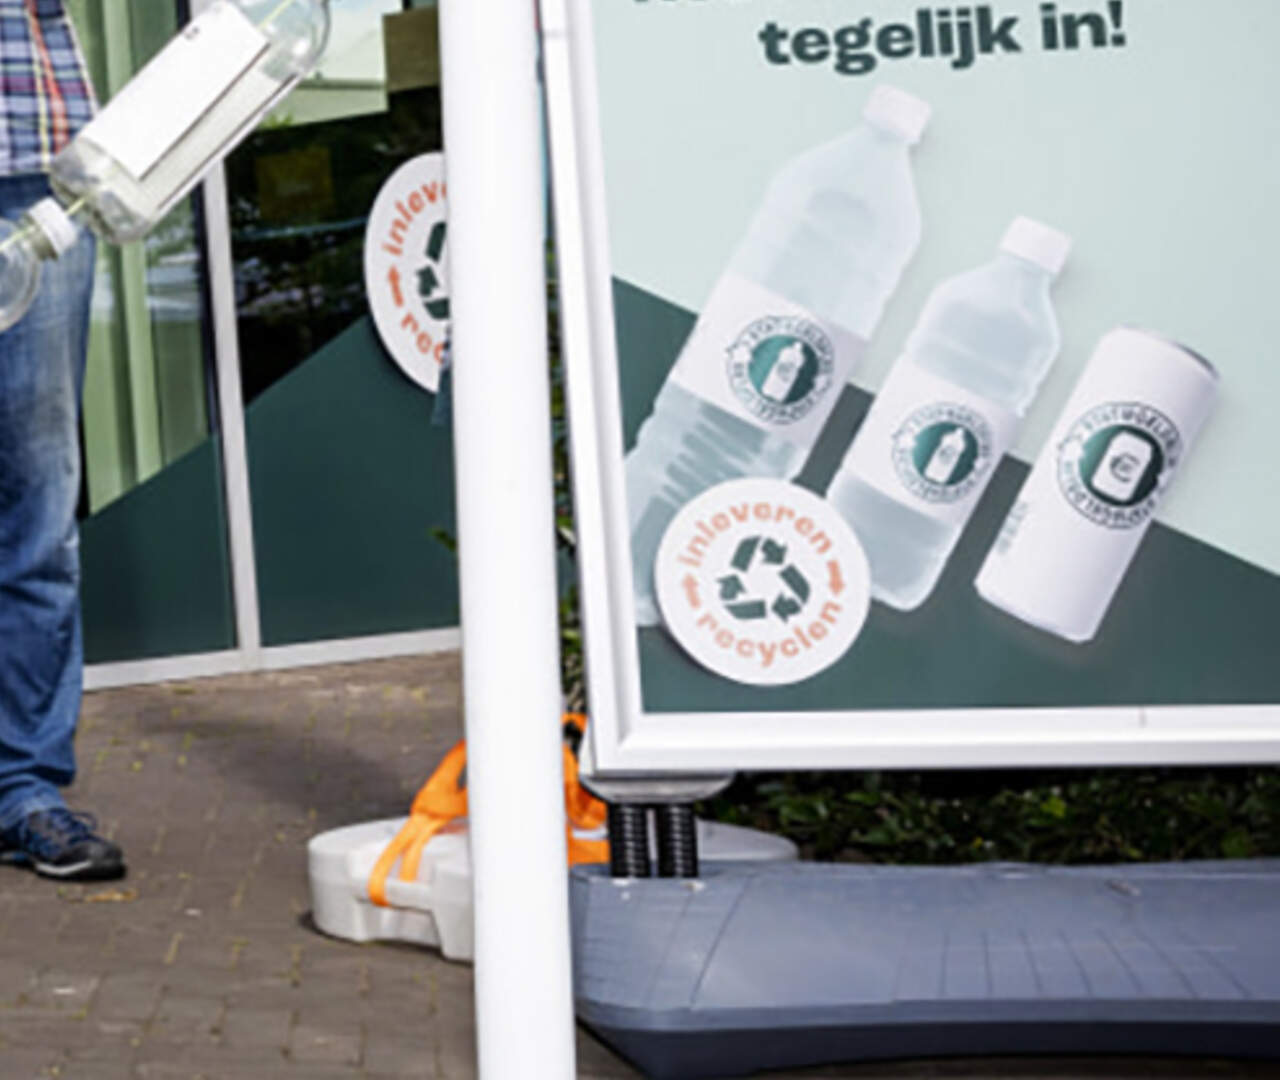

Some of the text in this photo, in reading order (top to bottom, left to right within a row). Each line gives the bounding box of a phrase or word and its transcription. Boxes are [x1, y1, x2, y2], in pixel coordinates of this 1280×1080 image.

[758, 0, 1128, 76] tegelijk in!
[381, 180, 446, 257] inlev
[677, 501, 833, 569] inleveren
[695, 600, 843, 669] recyclen
